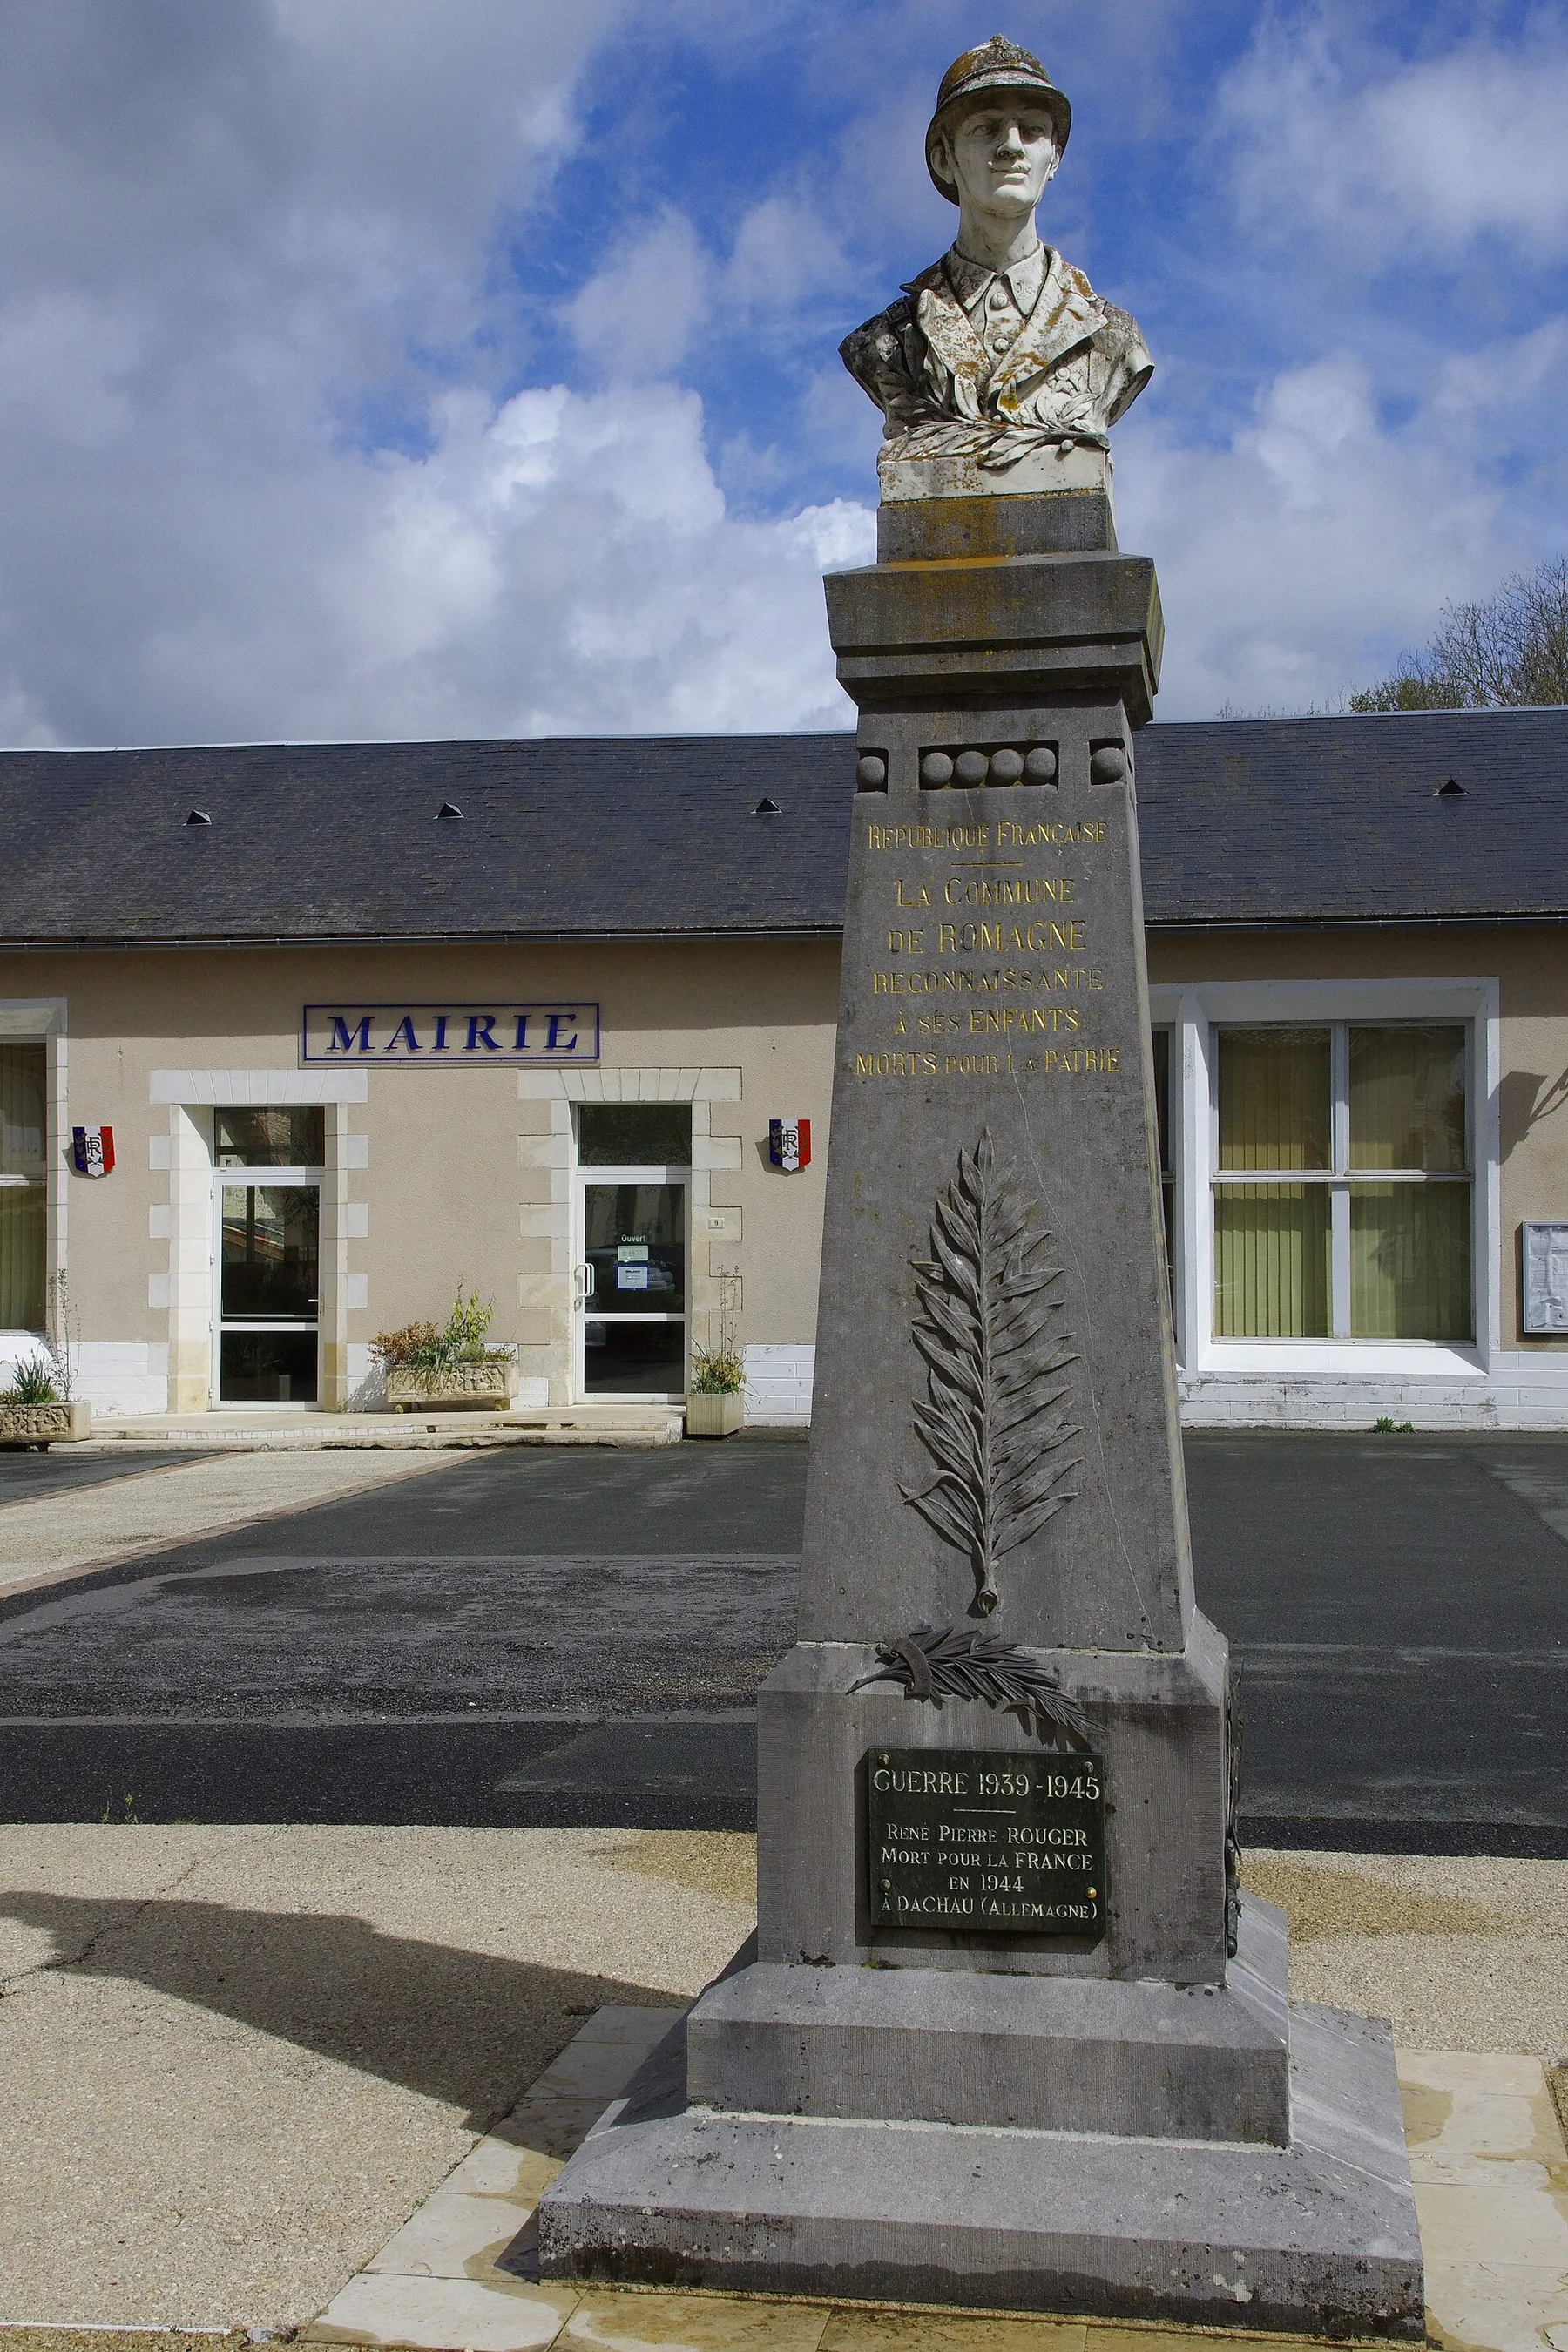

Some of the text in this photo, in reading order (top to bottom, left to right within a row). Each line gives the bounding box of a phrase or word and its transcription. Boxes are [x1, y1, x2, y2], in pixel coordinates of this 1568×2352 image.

[997, 821, 1108, 846] FRANÇAISE
[896, 877, 1075, 907] LA COMMUNE
[889, 919, 1086, 954] DE ROMAGNE
[873, 969, 1104, 994] RECONNAISSANTE
[327, 1013, 578, 1050] MAIRIE
[919, 1014, 960, 1034] SES
[969, 1008, 1080, 1033] ENFANTS
[855, 1049, 1122, 1077] MORTS POUR LA PATRIE
[621, 1233, 646, 1242] Ouvert
[874, 1769, 970, 1794] GUERRE
[978, 1773, 1030, 1797] 1939
[939, 1825, 997, 1842] PIERRE
[1007, 1827, 1089, 1847] ROUGER
[882, 1847, 1094, 1871] MORT POUR LA FRANCE
[949, 1874, 1025, 1892] EN 1944
[897, 1896, 974, 1914] DACHAU
[981, 1896, 1098, 1920] (ALLEMAGNE)
